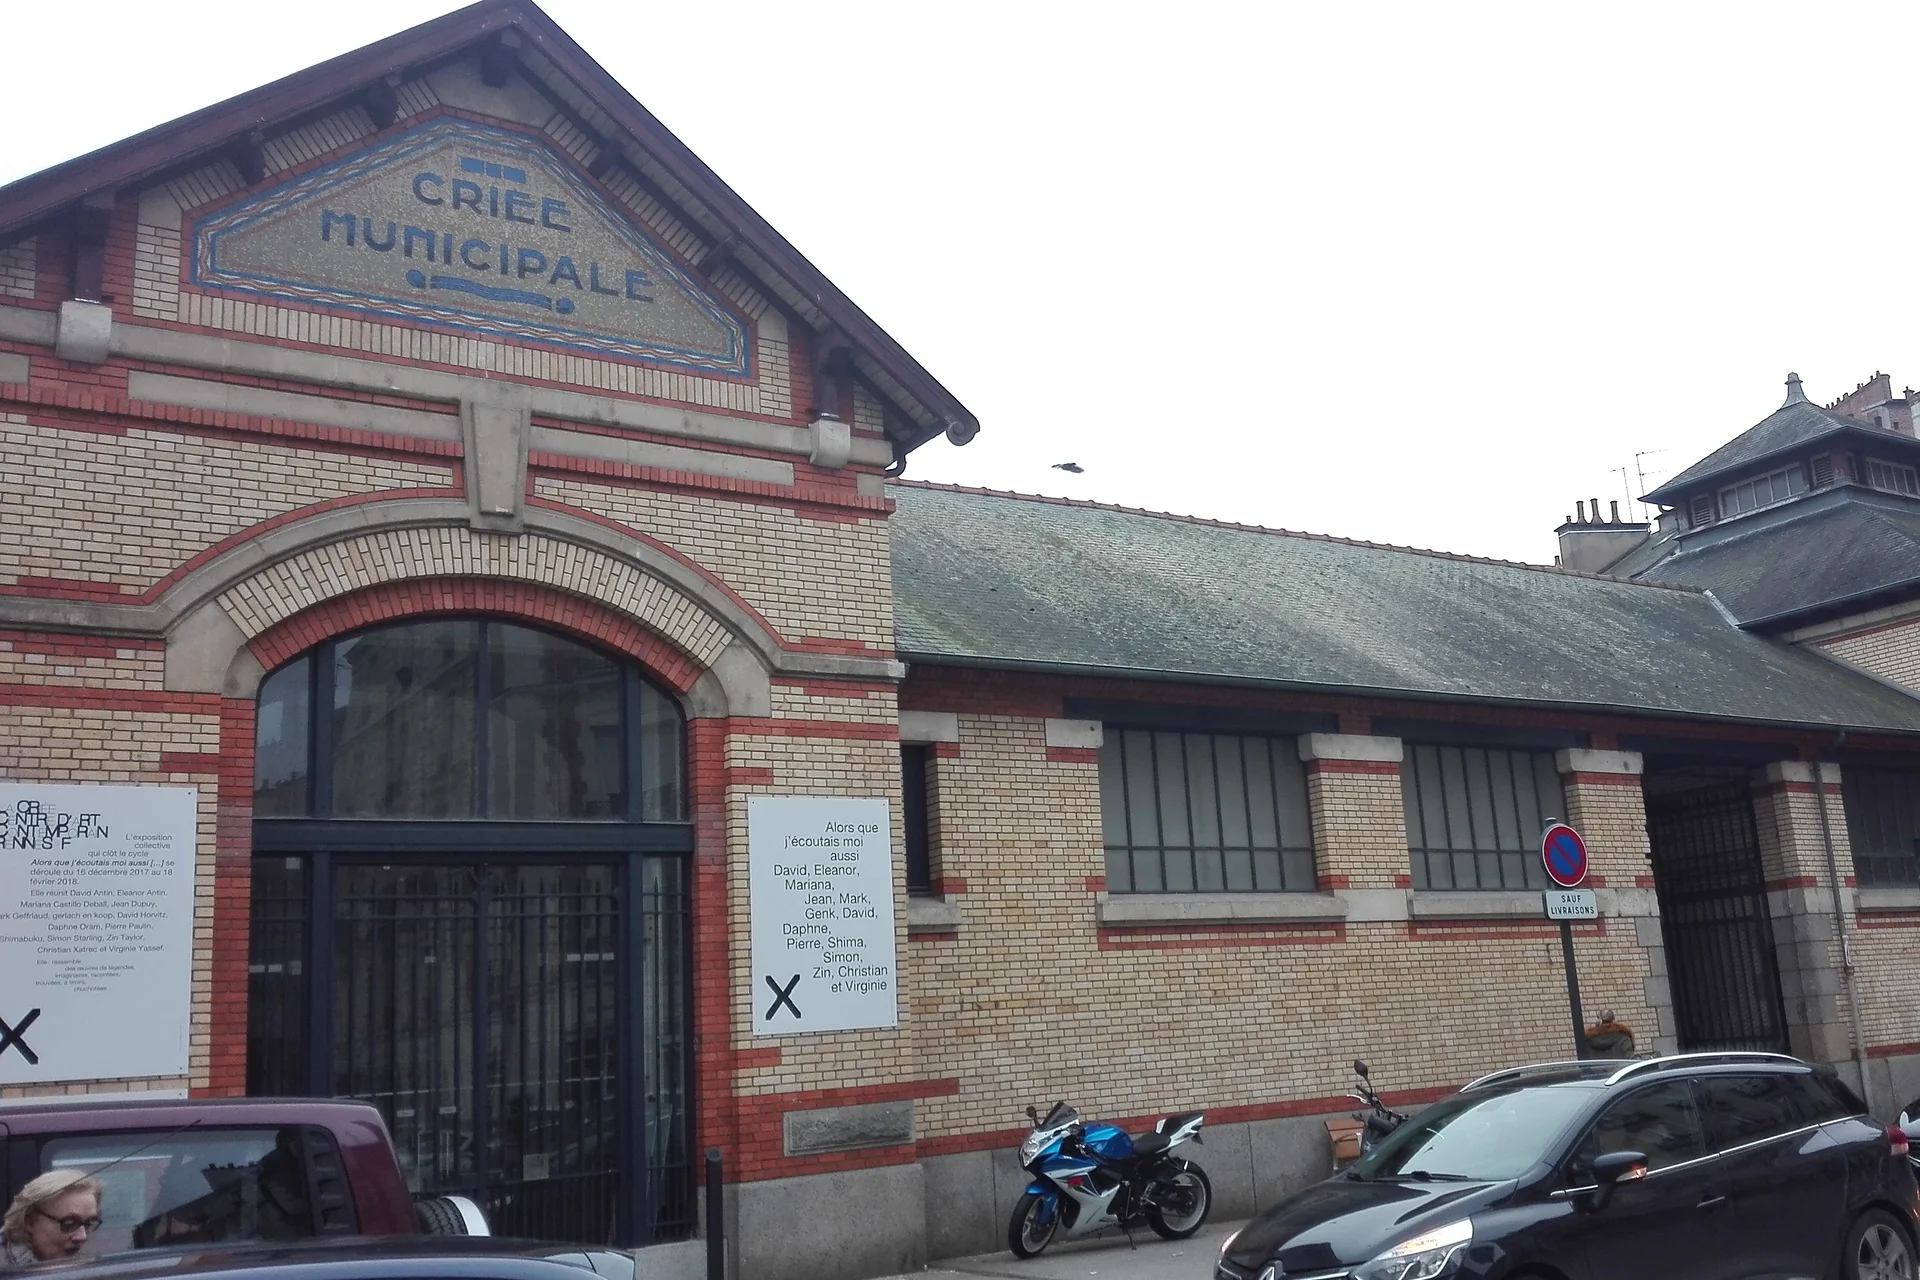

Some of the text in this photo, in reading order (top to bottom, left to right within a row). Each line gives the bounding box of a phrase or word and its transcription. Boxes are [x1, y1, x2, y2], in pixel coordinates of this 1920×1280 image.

[412, 172, 571, 233] CRIEE
[321, 209, 656, 302] MUNICIPALE
[825, 821, 879, 835] Alors que
[125, 834, 173, 842] L'exposition
[784, 835, 864, 849] j'écoutais moi
[134, 841, 171, 849] collective
[128, 850, 149, 858] cycle
[830, 850, 860, 861] aussi
[54, 860, 70, 868] que
[71, 859, 110, 867] j'écoutais
[30, 868, 61, 876] déroule
[62, 868, 74, 876] du
[76, 868, 86, 876] 16
[88, 868, 128, 876] décembre
[130, 868, 149, 876] 2017
[163, 868, 173, 876] 18
[774, 864, 860, 877] David, Eleanor,
[30, 877, 55, 885] février
[785, 879, 835, 892] Mariana,
[30, 889, 45, 897] Elle
[70, 889, 91, 897] David
[93, 889, 115, 898] Antin,
[117, 888, 146, 897] Eleanor
[147, 889, 168, 898] Antin,
[1561, 895, 1581, 903] SAUF
[131, 901, 157, 909] Dupuy,
[804, 893, 871, 907] Jean, Mark,
[805, 907, 878, 920] Genk, David,
[1551, 906, 1594, 915] LIVRAISONS
[783, 923, 831, 936] Daphne,
[787, 936, 867, 950] Pierre, Shima,
[823, 951, 863, 963] Simon,
[813, 965, 888, 979] Zin, Christian
[831, 980, 888, 994] et Virginie
